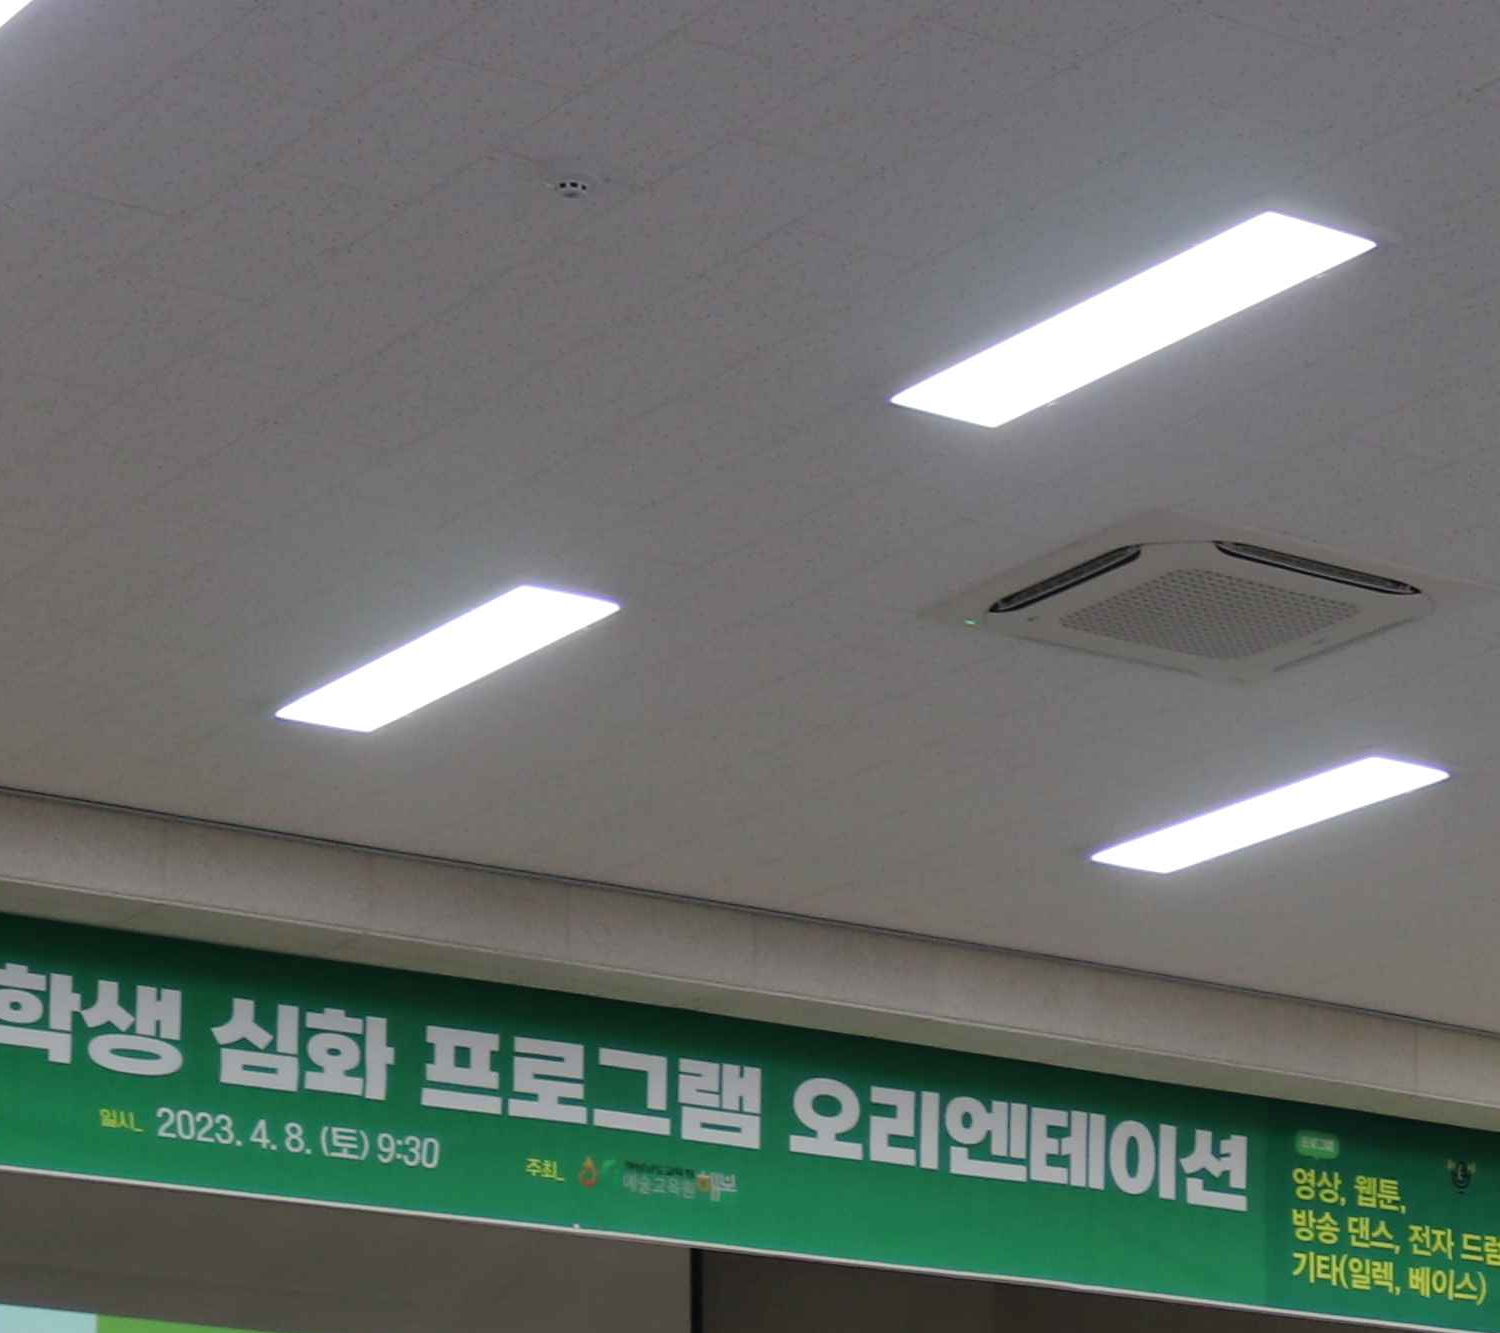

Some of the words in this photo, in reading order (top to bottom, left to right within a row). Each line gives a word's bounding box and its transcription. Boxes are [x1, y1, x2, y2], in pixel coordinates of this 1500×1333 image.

[211, 997, 396, 1101] 심화
[420, 1024, 763, 1150] 프로그램
[788, 1076, 1249, 1213] 오리엔테이션
[156, 1107, 242, 1146] 2023.
[250, 1119, 278, 1151] 4.
[284, 1122, 312, 1155] 8.
[320, 1125, 370, 1161] (토)
[377, 1132, 441, 1168] 9:30
[1292, 1168, 1347, 1206] 영상,
[1355, 1175, 1407, 1214] 웹툰,
[1291, 1209, 1341, 1245] 방송
[1348, 1216, 1401, 1254] 댄스,
[1408, 1224, 1456, 1259] 전자
[1292, 1251, 1401, 1295] 기타(일렉,
[1408, 1266, 1488, 1306] 베이스)
